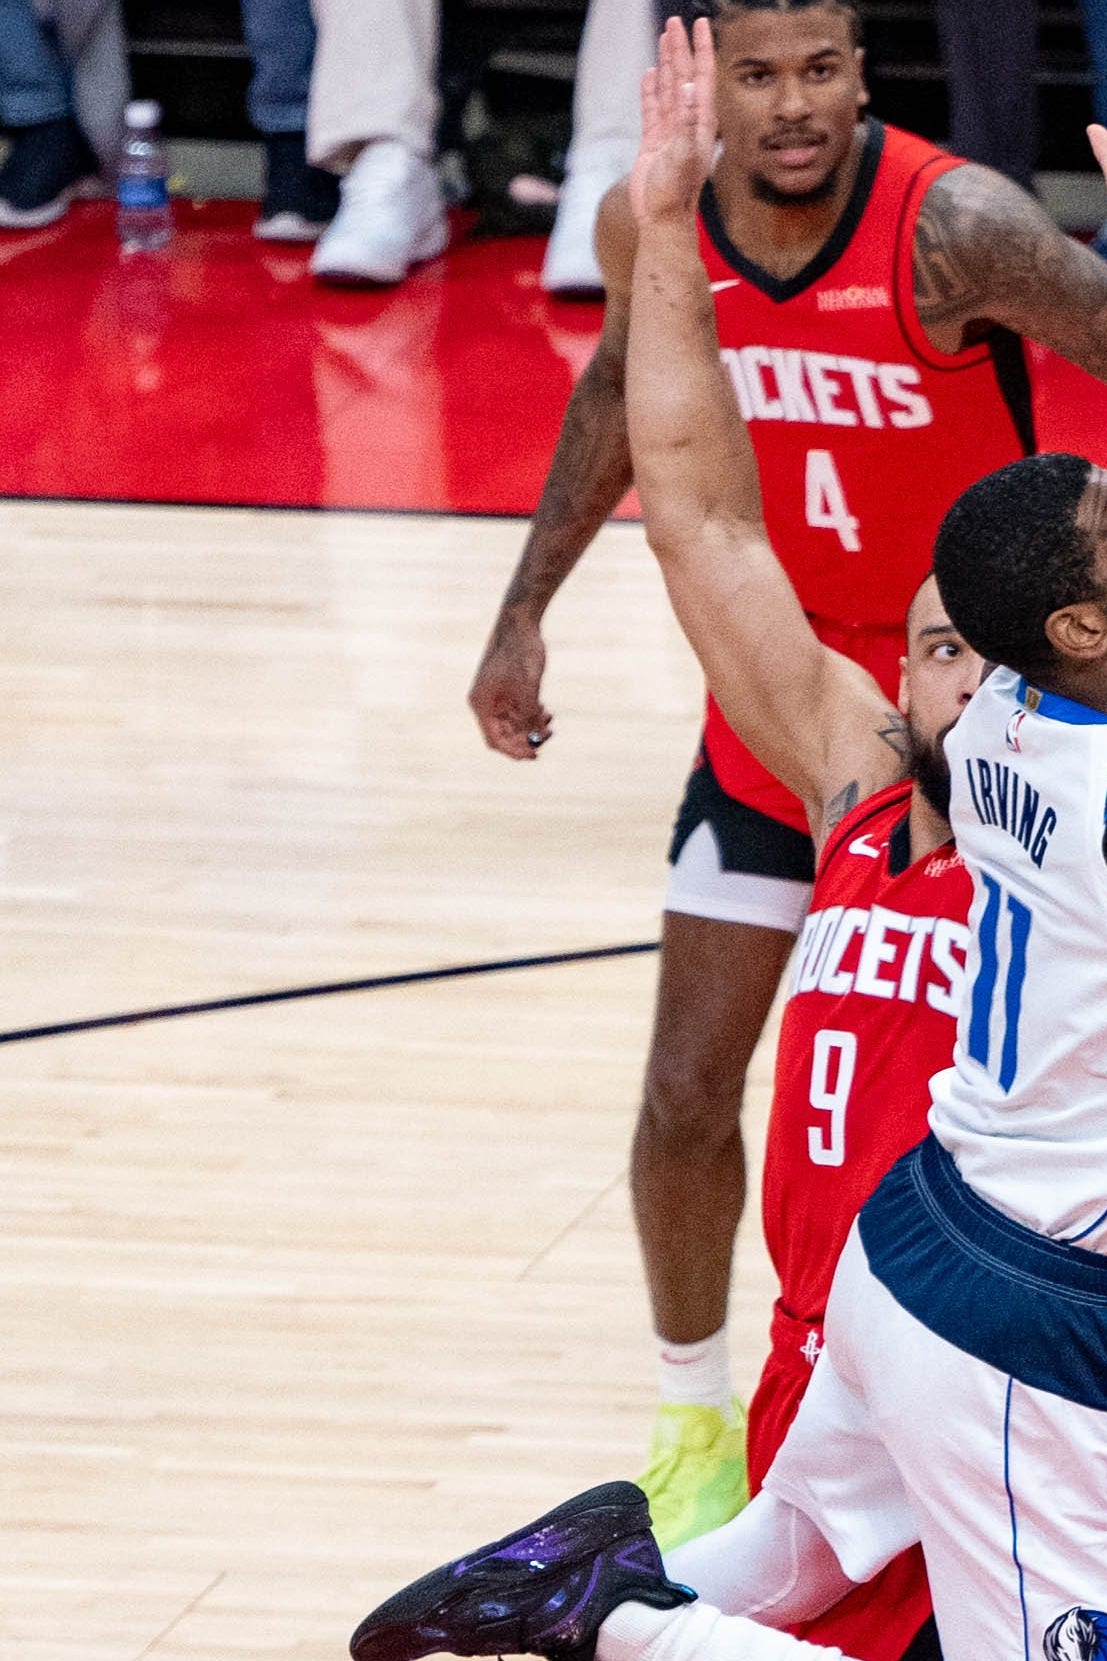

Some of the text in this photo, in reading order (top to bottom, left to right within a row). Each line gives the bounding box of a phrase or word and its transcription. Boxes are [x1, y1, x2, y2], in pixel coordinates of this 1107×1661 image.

[804, 449, 862, 552] 4
[966, 758, 1057, 869] IRVING
[968, 870, 1032, 1095] 11
[807, 1029, 858, 1167] 9
